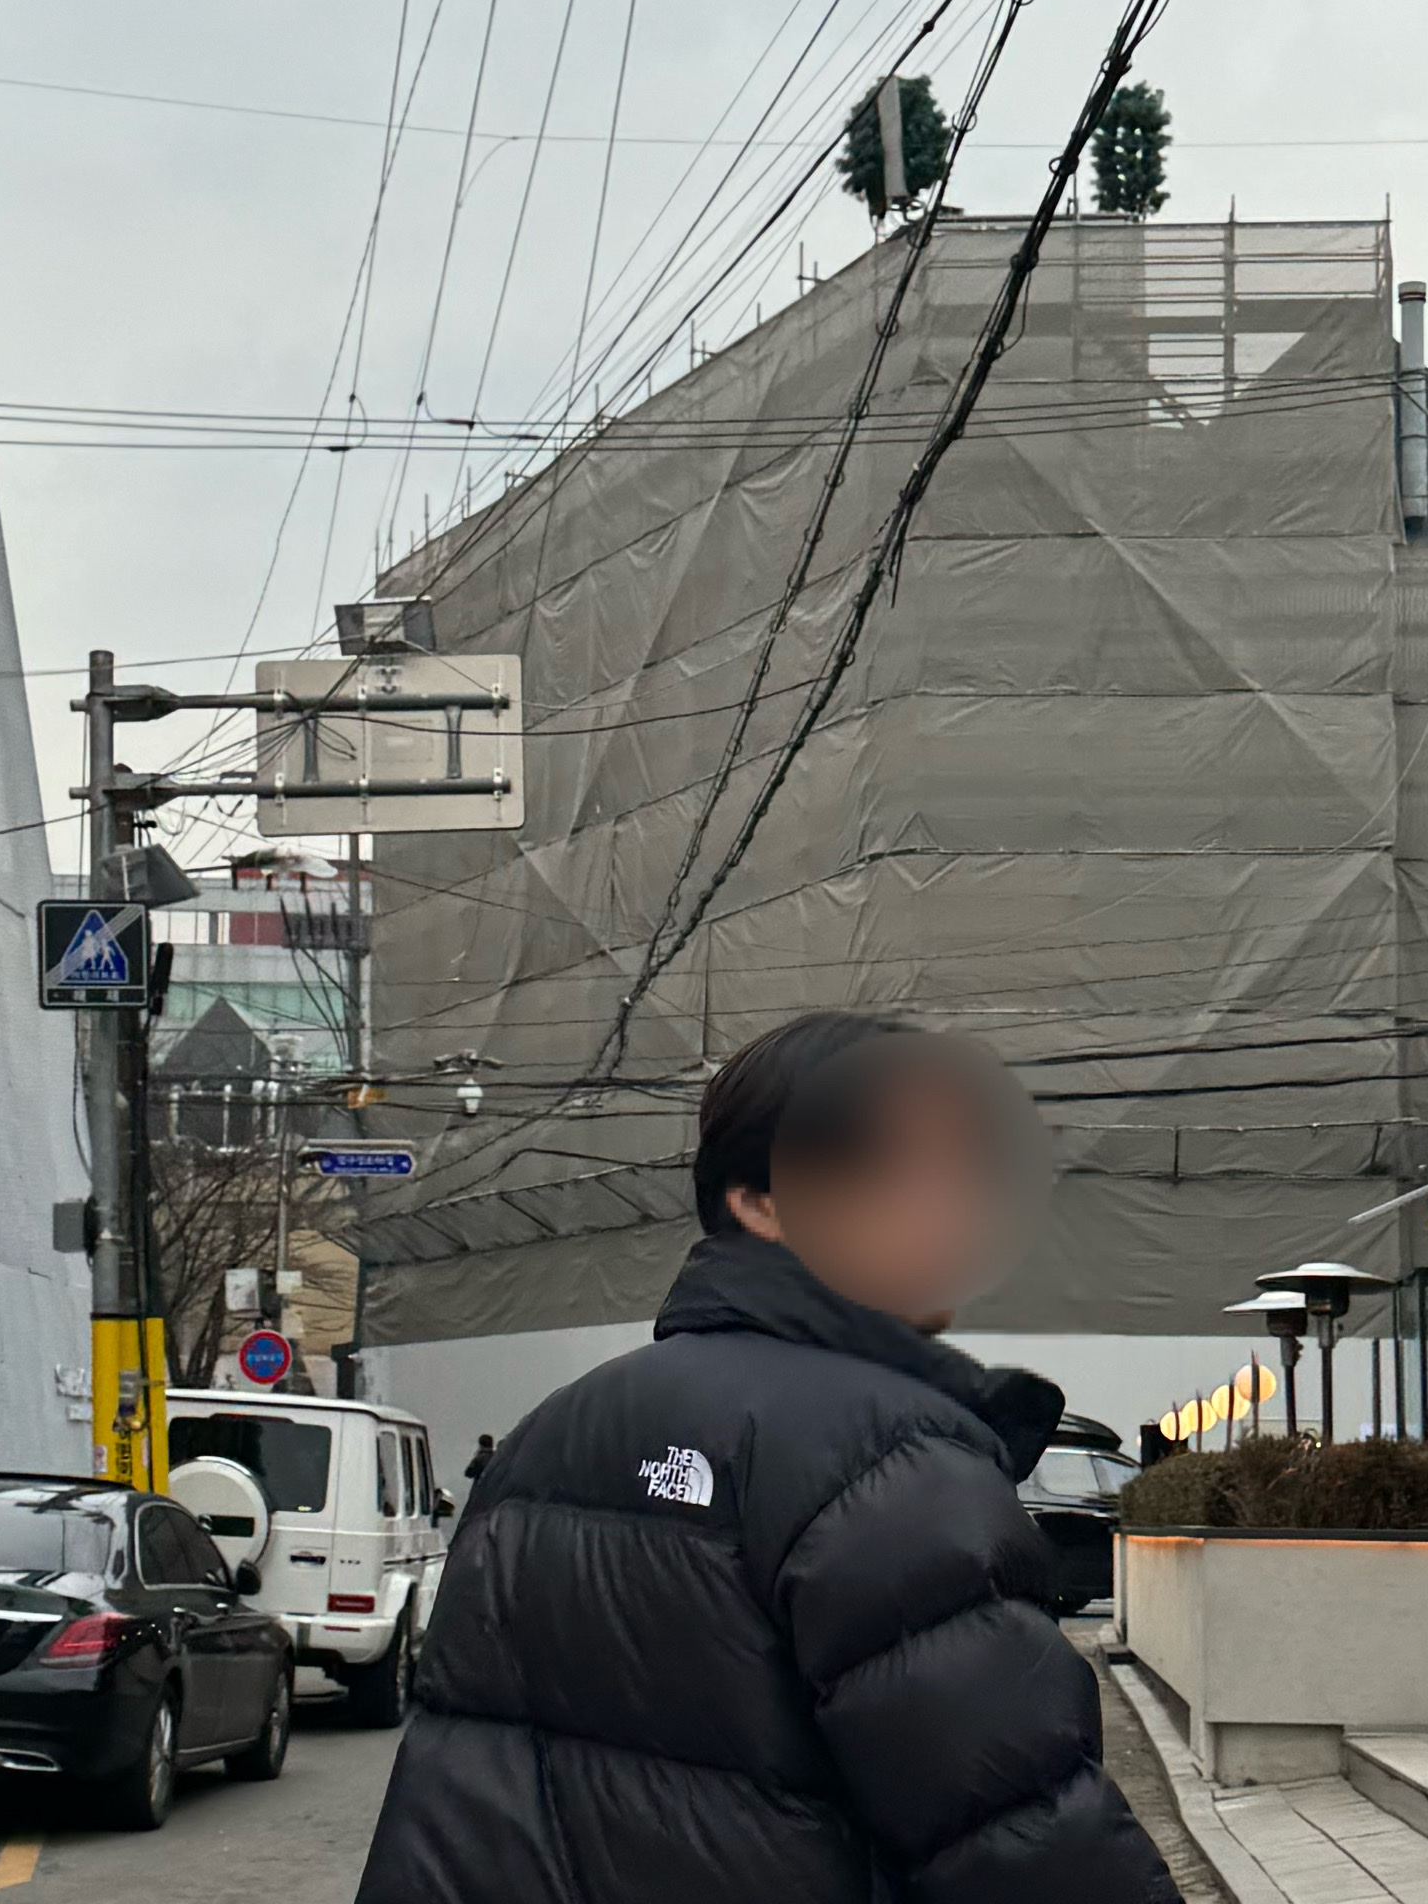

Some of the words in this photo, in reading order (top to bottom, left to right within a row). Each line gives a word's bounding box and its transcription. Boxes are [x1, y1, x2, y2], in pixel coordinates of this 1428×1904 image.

[667, 1445, 693, 1466] THE
[638, 1459, 689, 1485] NORTH
[647, 1478, 686, 1502] FACE
